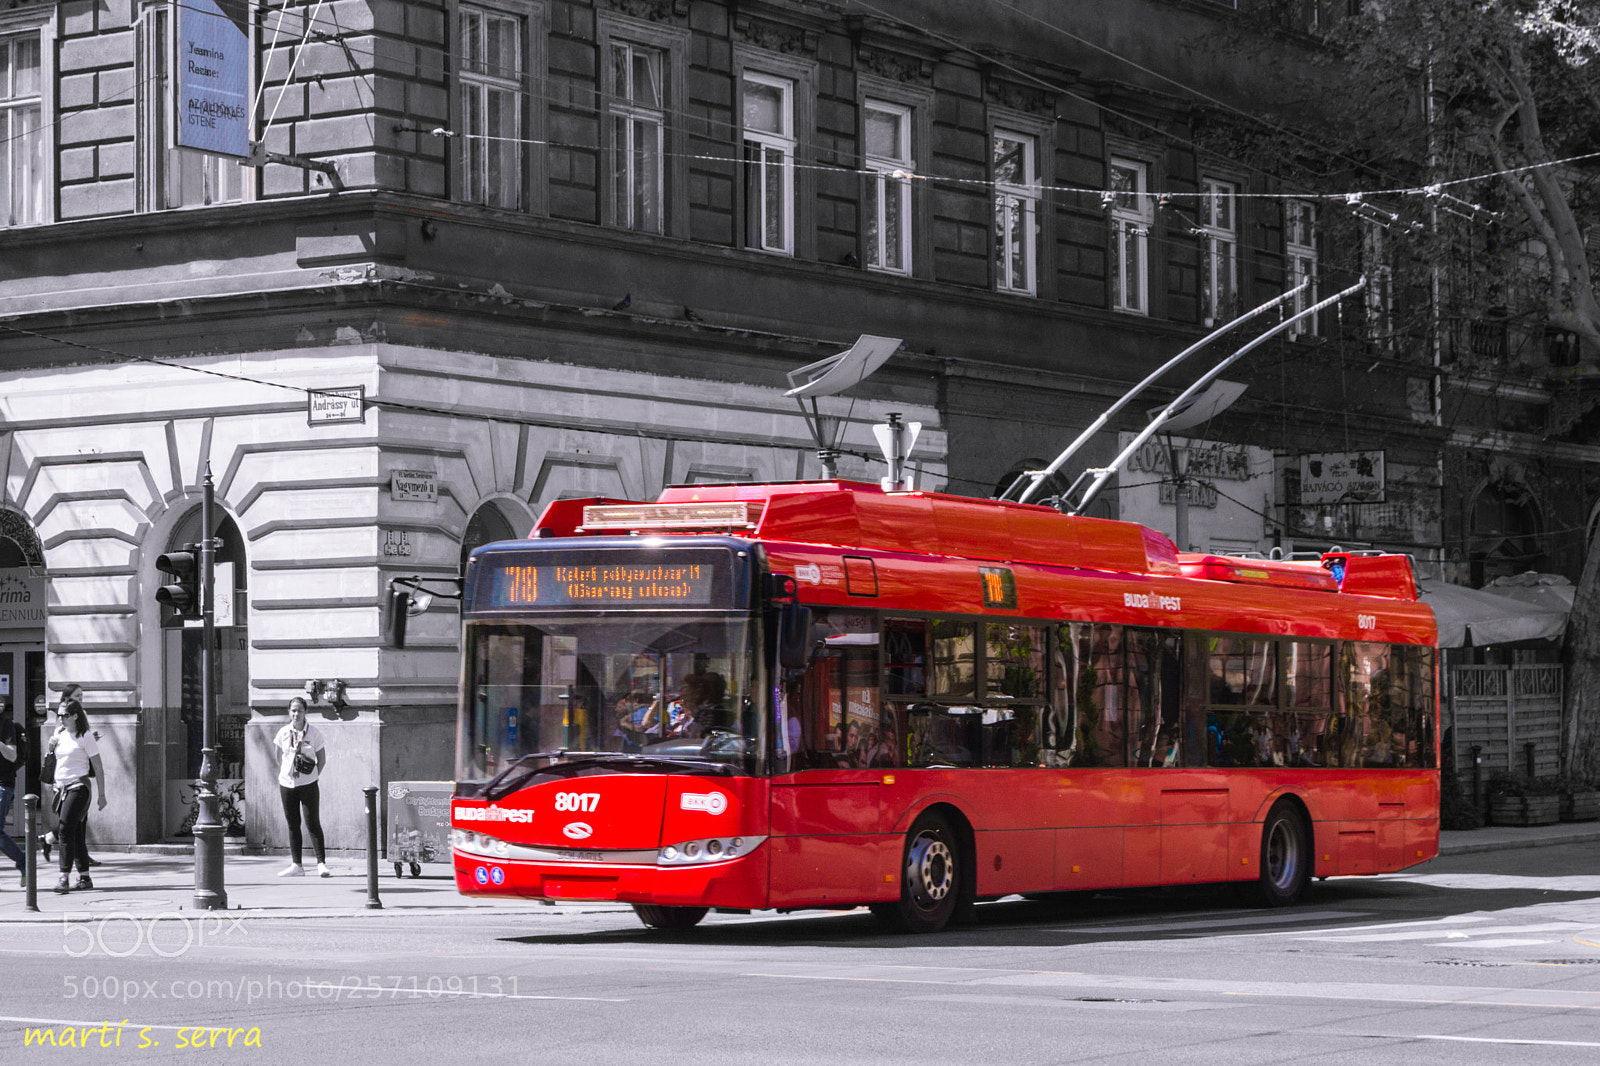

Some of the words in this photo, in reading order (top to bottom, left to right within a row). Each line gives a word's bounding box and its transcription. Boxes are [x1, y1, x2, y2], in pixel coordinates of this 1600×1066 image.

[313, 399, 347, 414] Andrássy
[1358, 615, 1376, 630] 8017
[555, 792, 600, 812] 8017
